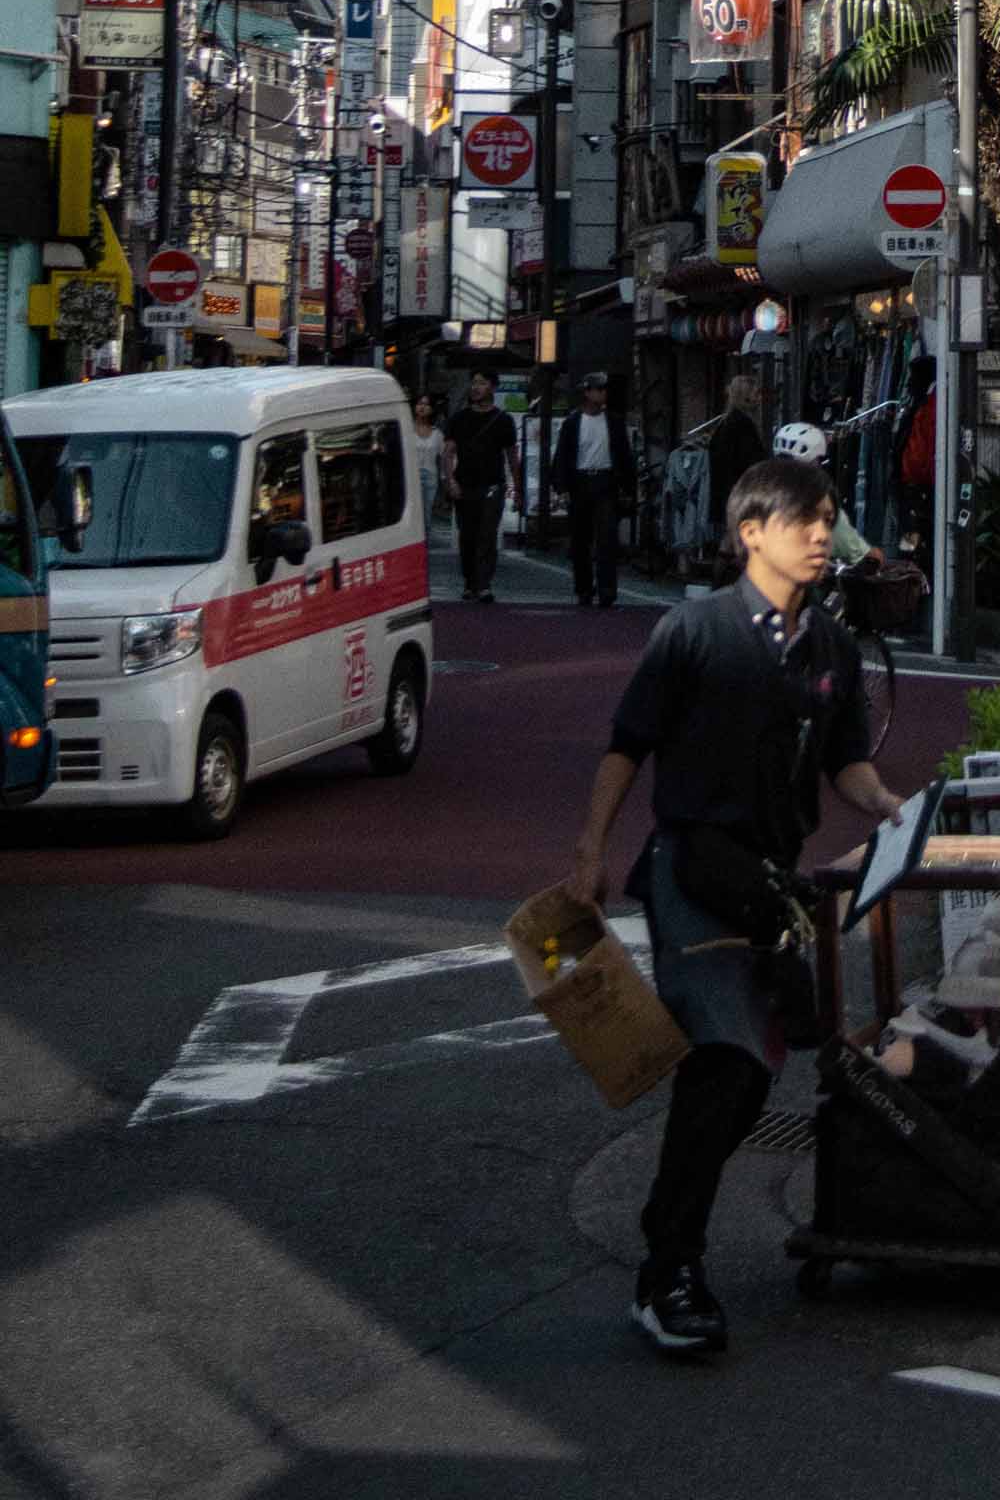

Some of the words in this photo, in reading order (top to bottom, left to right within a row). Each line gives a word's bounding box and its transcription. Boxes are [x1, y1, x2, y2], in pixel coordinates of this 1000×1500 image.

[887, 236, 943, 251] 自転車を除く
